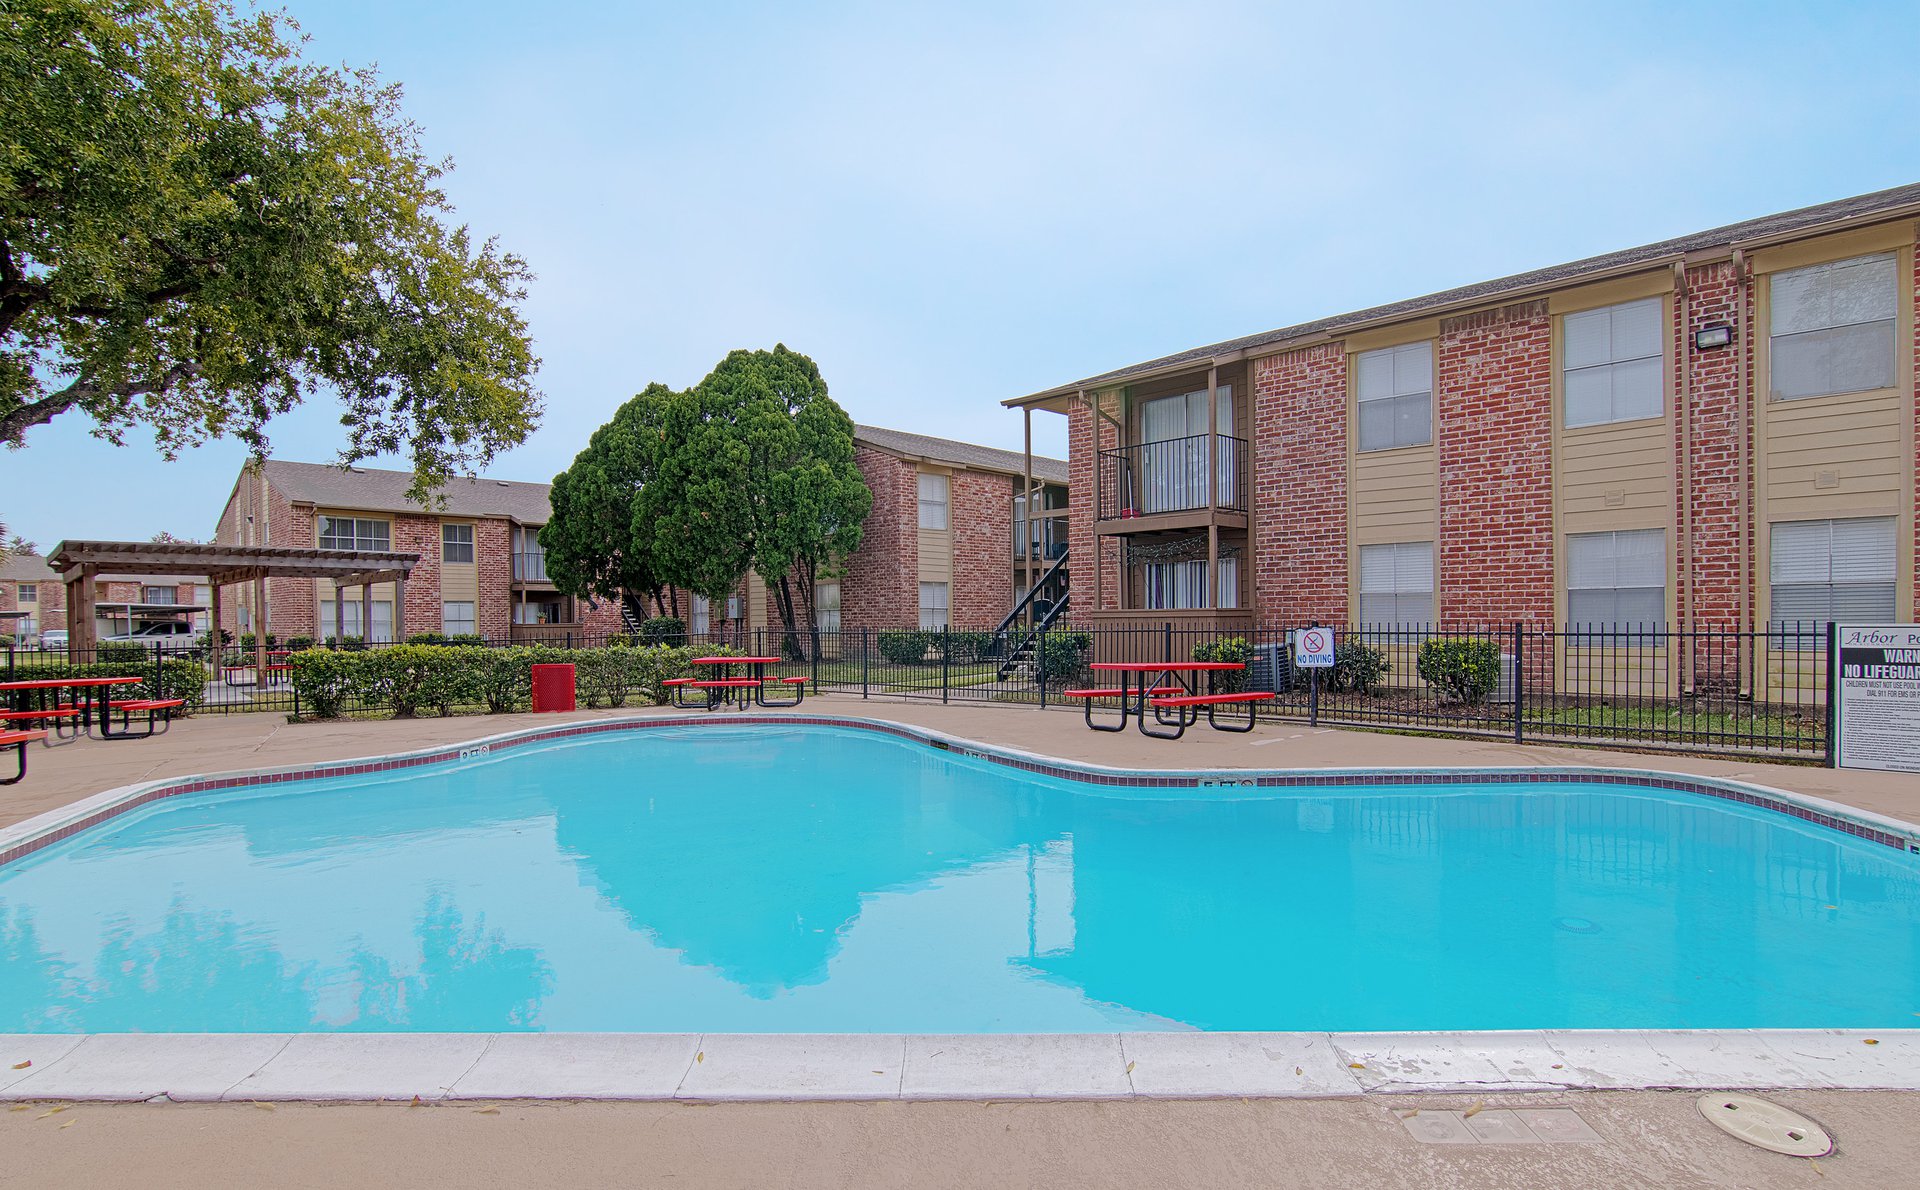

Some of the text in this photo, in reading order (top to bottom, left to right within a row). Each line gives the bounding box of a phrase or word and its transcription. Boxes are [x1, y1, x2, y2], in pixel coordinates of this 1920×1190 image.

[1845, 630, 1898, 645] Arbor
[1297, 654, 1332, 664] NO DIVING
[1883, 649, 1920, 663] WARN
[1844, 664, 1860, 678] NO
[1846, 680, 1868, 688] CHILDREN
[1869, 681, 1882, 689] MUST
[1883, 681, 1893, 689] NOT
[1893, 681, 1903, 689] USE
[1904, 682, 1916, 690] POOL
